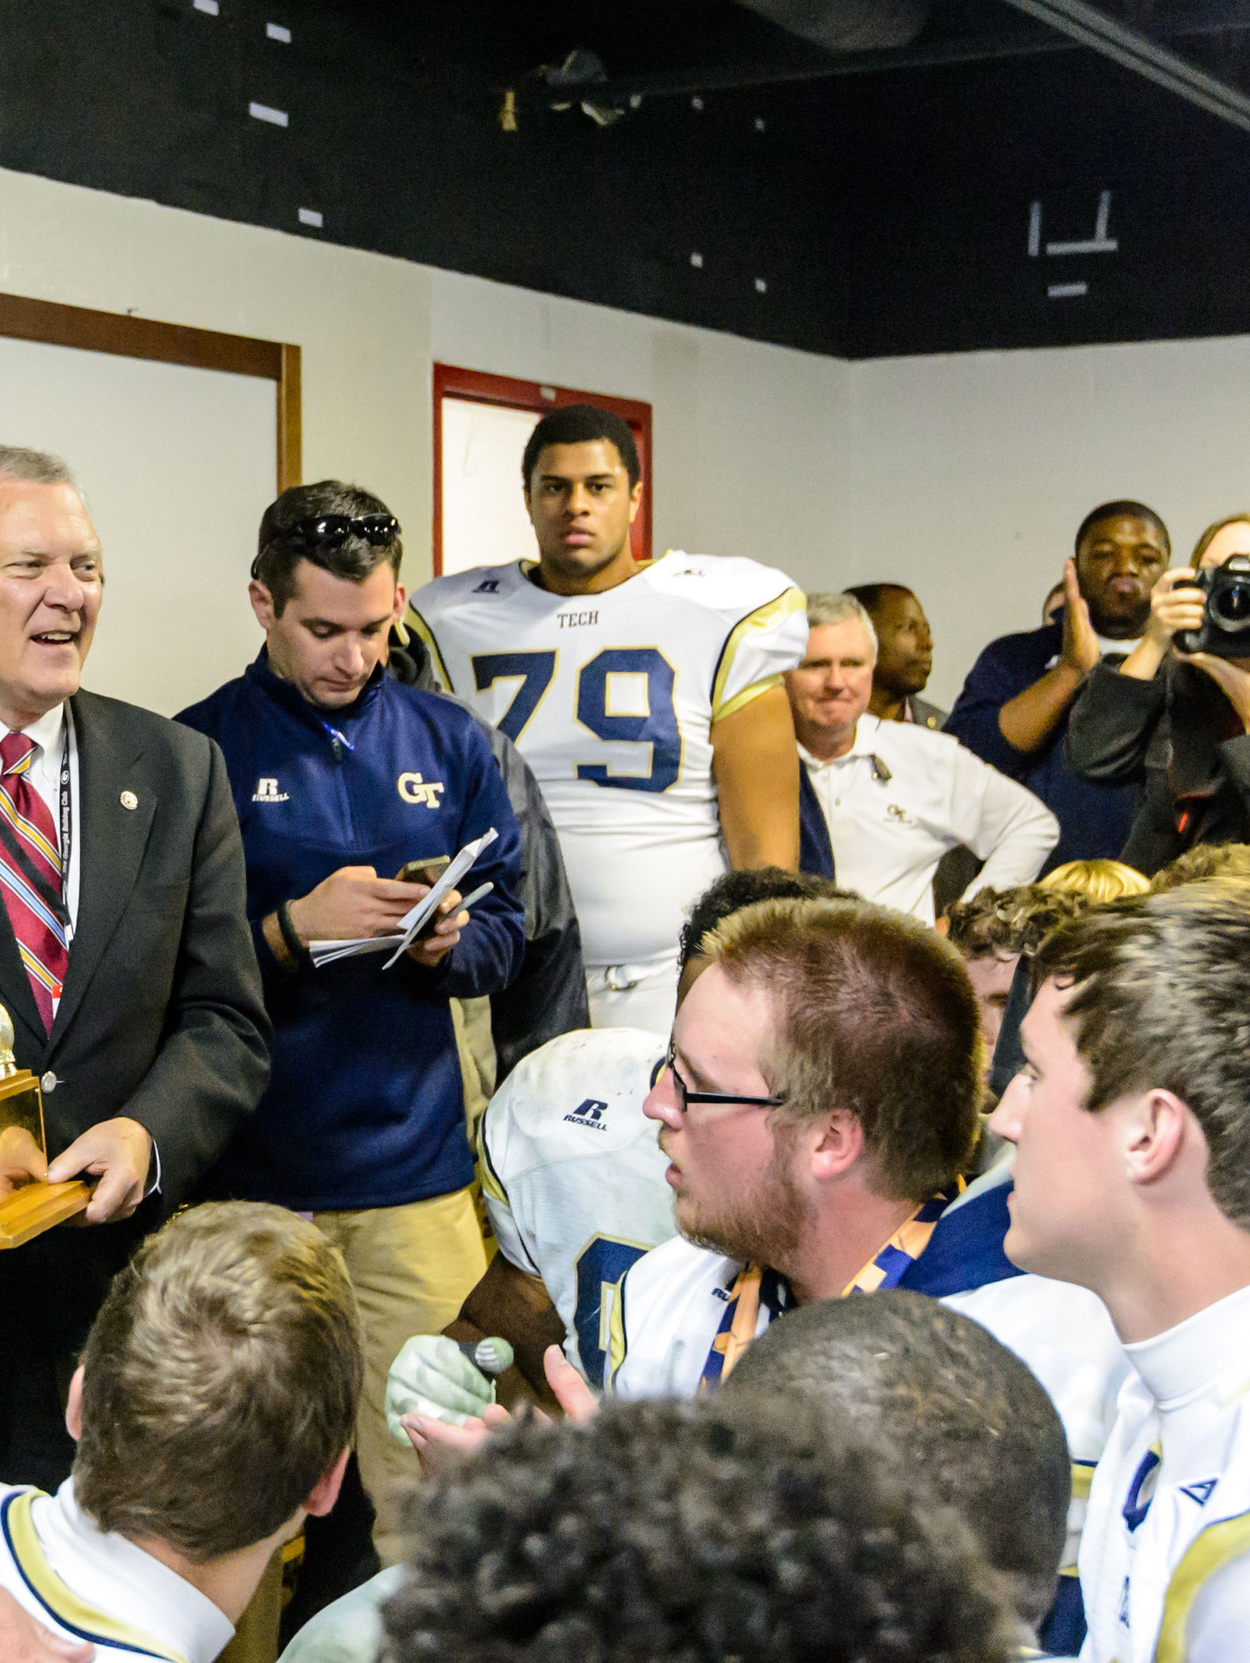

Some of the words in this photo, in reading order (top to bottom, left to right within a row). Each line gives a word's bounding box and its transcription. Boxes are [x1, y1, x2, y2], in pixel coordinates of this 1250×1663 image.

[557, 610, 600, 629] TECH
[469, 644, 685, 794] 79
[397, 771, 445, 809] GT
[563, 1114, 607, 1131] RUSSELL
